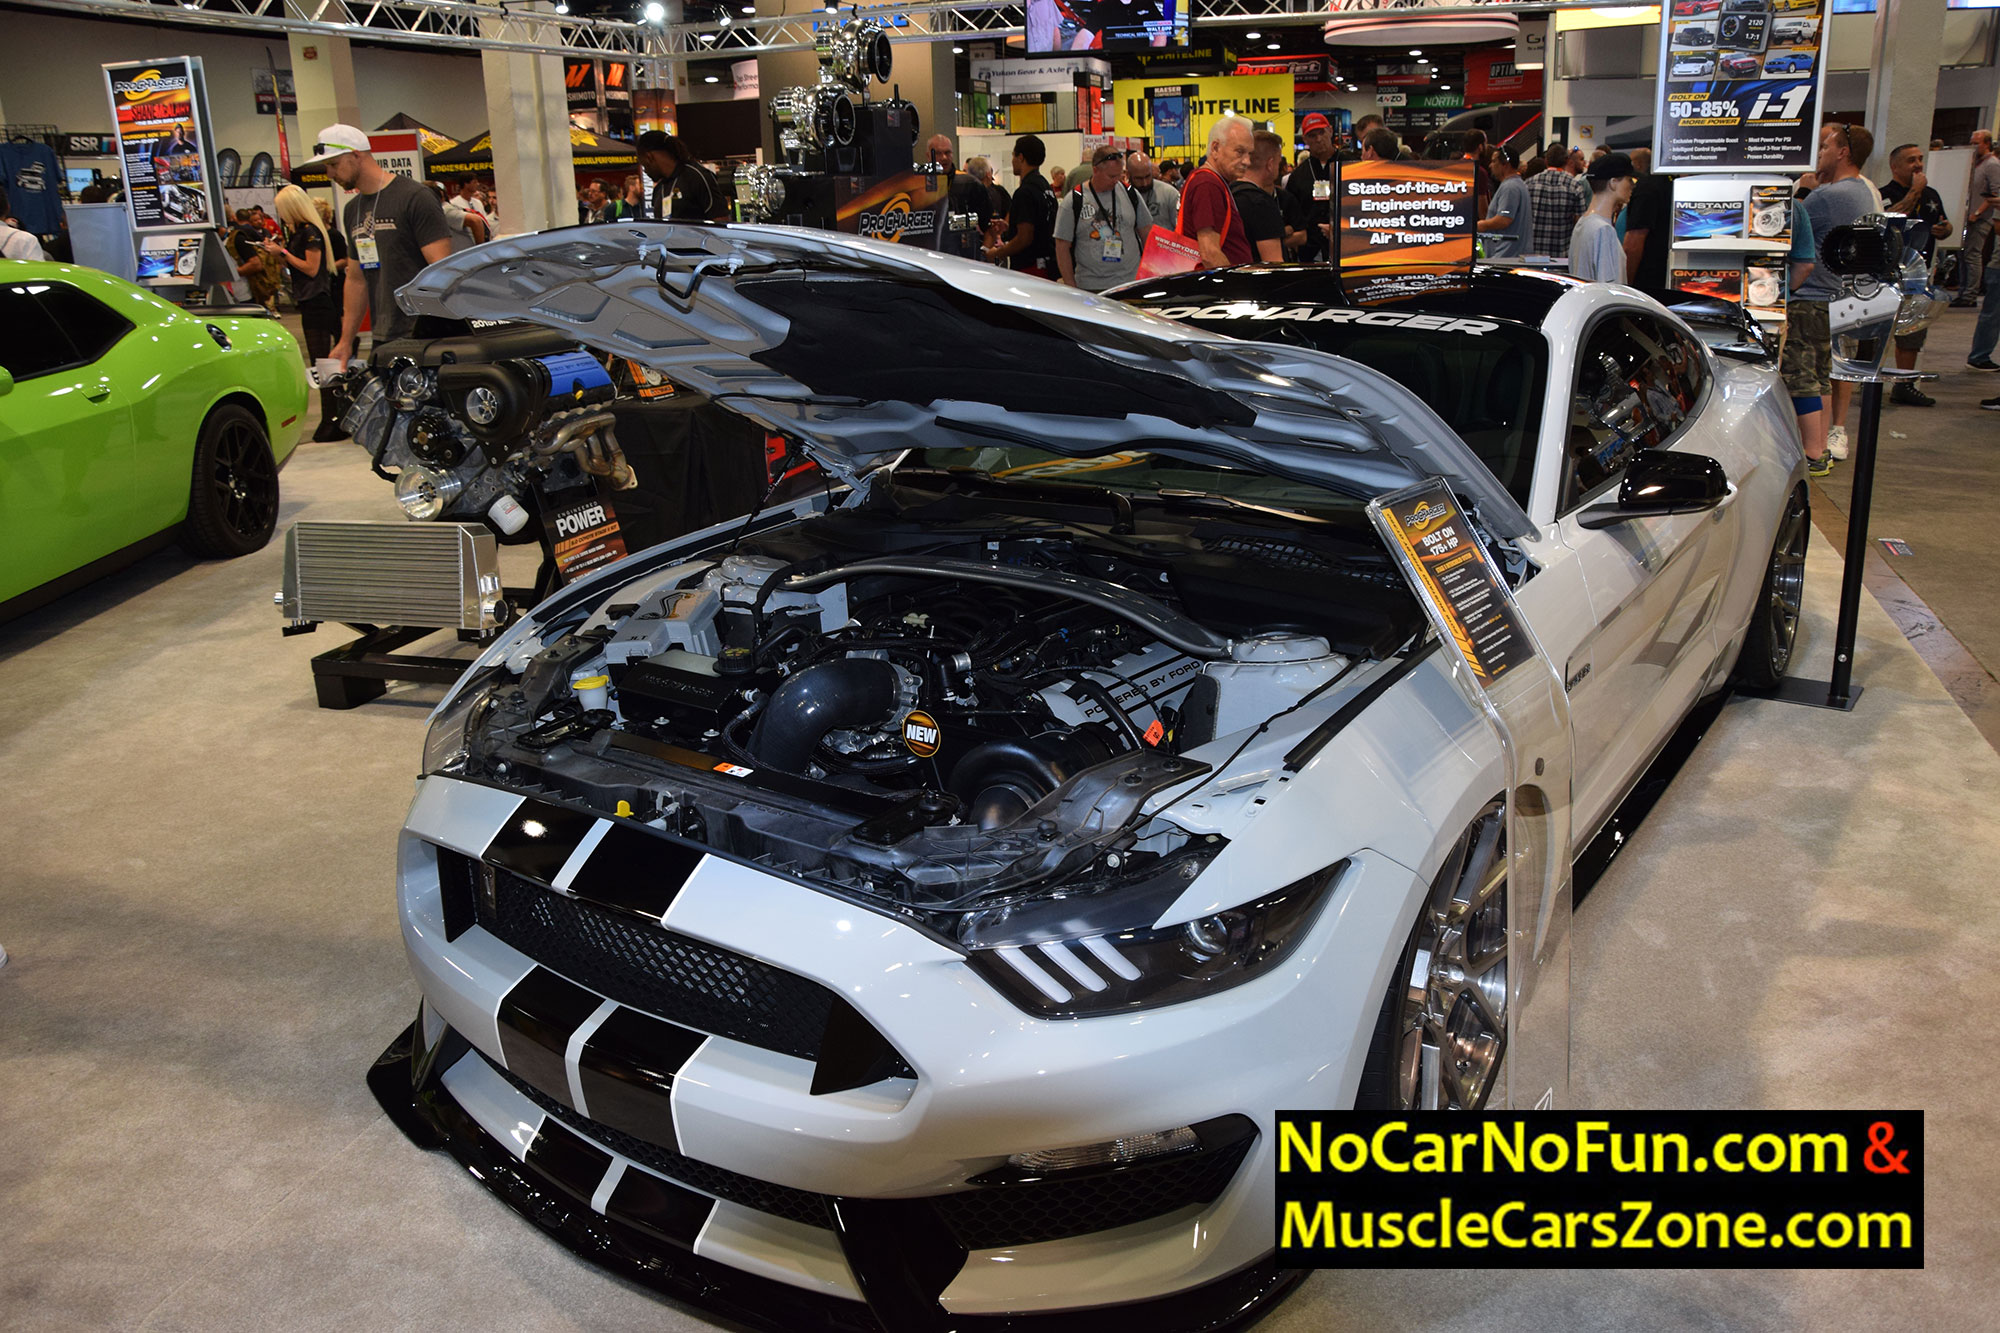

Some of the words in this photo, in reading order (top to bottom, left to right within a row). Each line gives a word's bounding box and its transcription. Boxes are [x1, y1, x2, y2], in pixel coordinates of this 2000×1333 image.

[1017, 68, 1037, 76] Gear
[1424, 97, 1459, 106] NORTH
[1670, 100, 1739, 118] 50-85%
[70, 136, 99, 151] SSR
[391, 158, 412, 168] DATA
[1348, 181, 1467, 195] State-of-the-Art
[1361, 198, 1454, 213] Engineering,
[858, 210, 935, 236] PROCHARGER
[1349, 215, 1406, 228] Lowest
[1409, 214, 1465, 229] Charge
[1370, 232, 1392, 244] Air
[1395, 232, 1445, 245] Temps
[1141, 302, 1500, 336] OCHARGER
[557, 501, 598, 519] ENGINEERED
[555, 505, 606, 537] POWER
[1422, 530, 1443, 547] BOLT
[1441, 526, 1455, 538] ON
[1430, 543, 1448, 556] 175+
[1447, 537, 1459, 548] HP
[1085, 686, 1148, 718] POERED
[1150, 675, 1167, 688] BY
[1168, 660, 1200, 680] FORD
[906, 724, 938, 744] NEW
